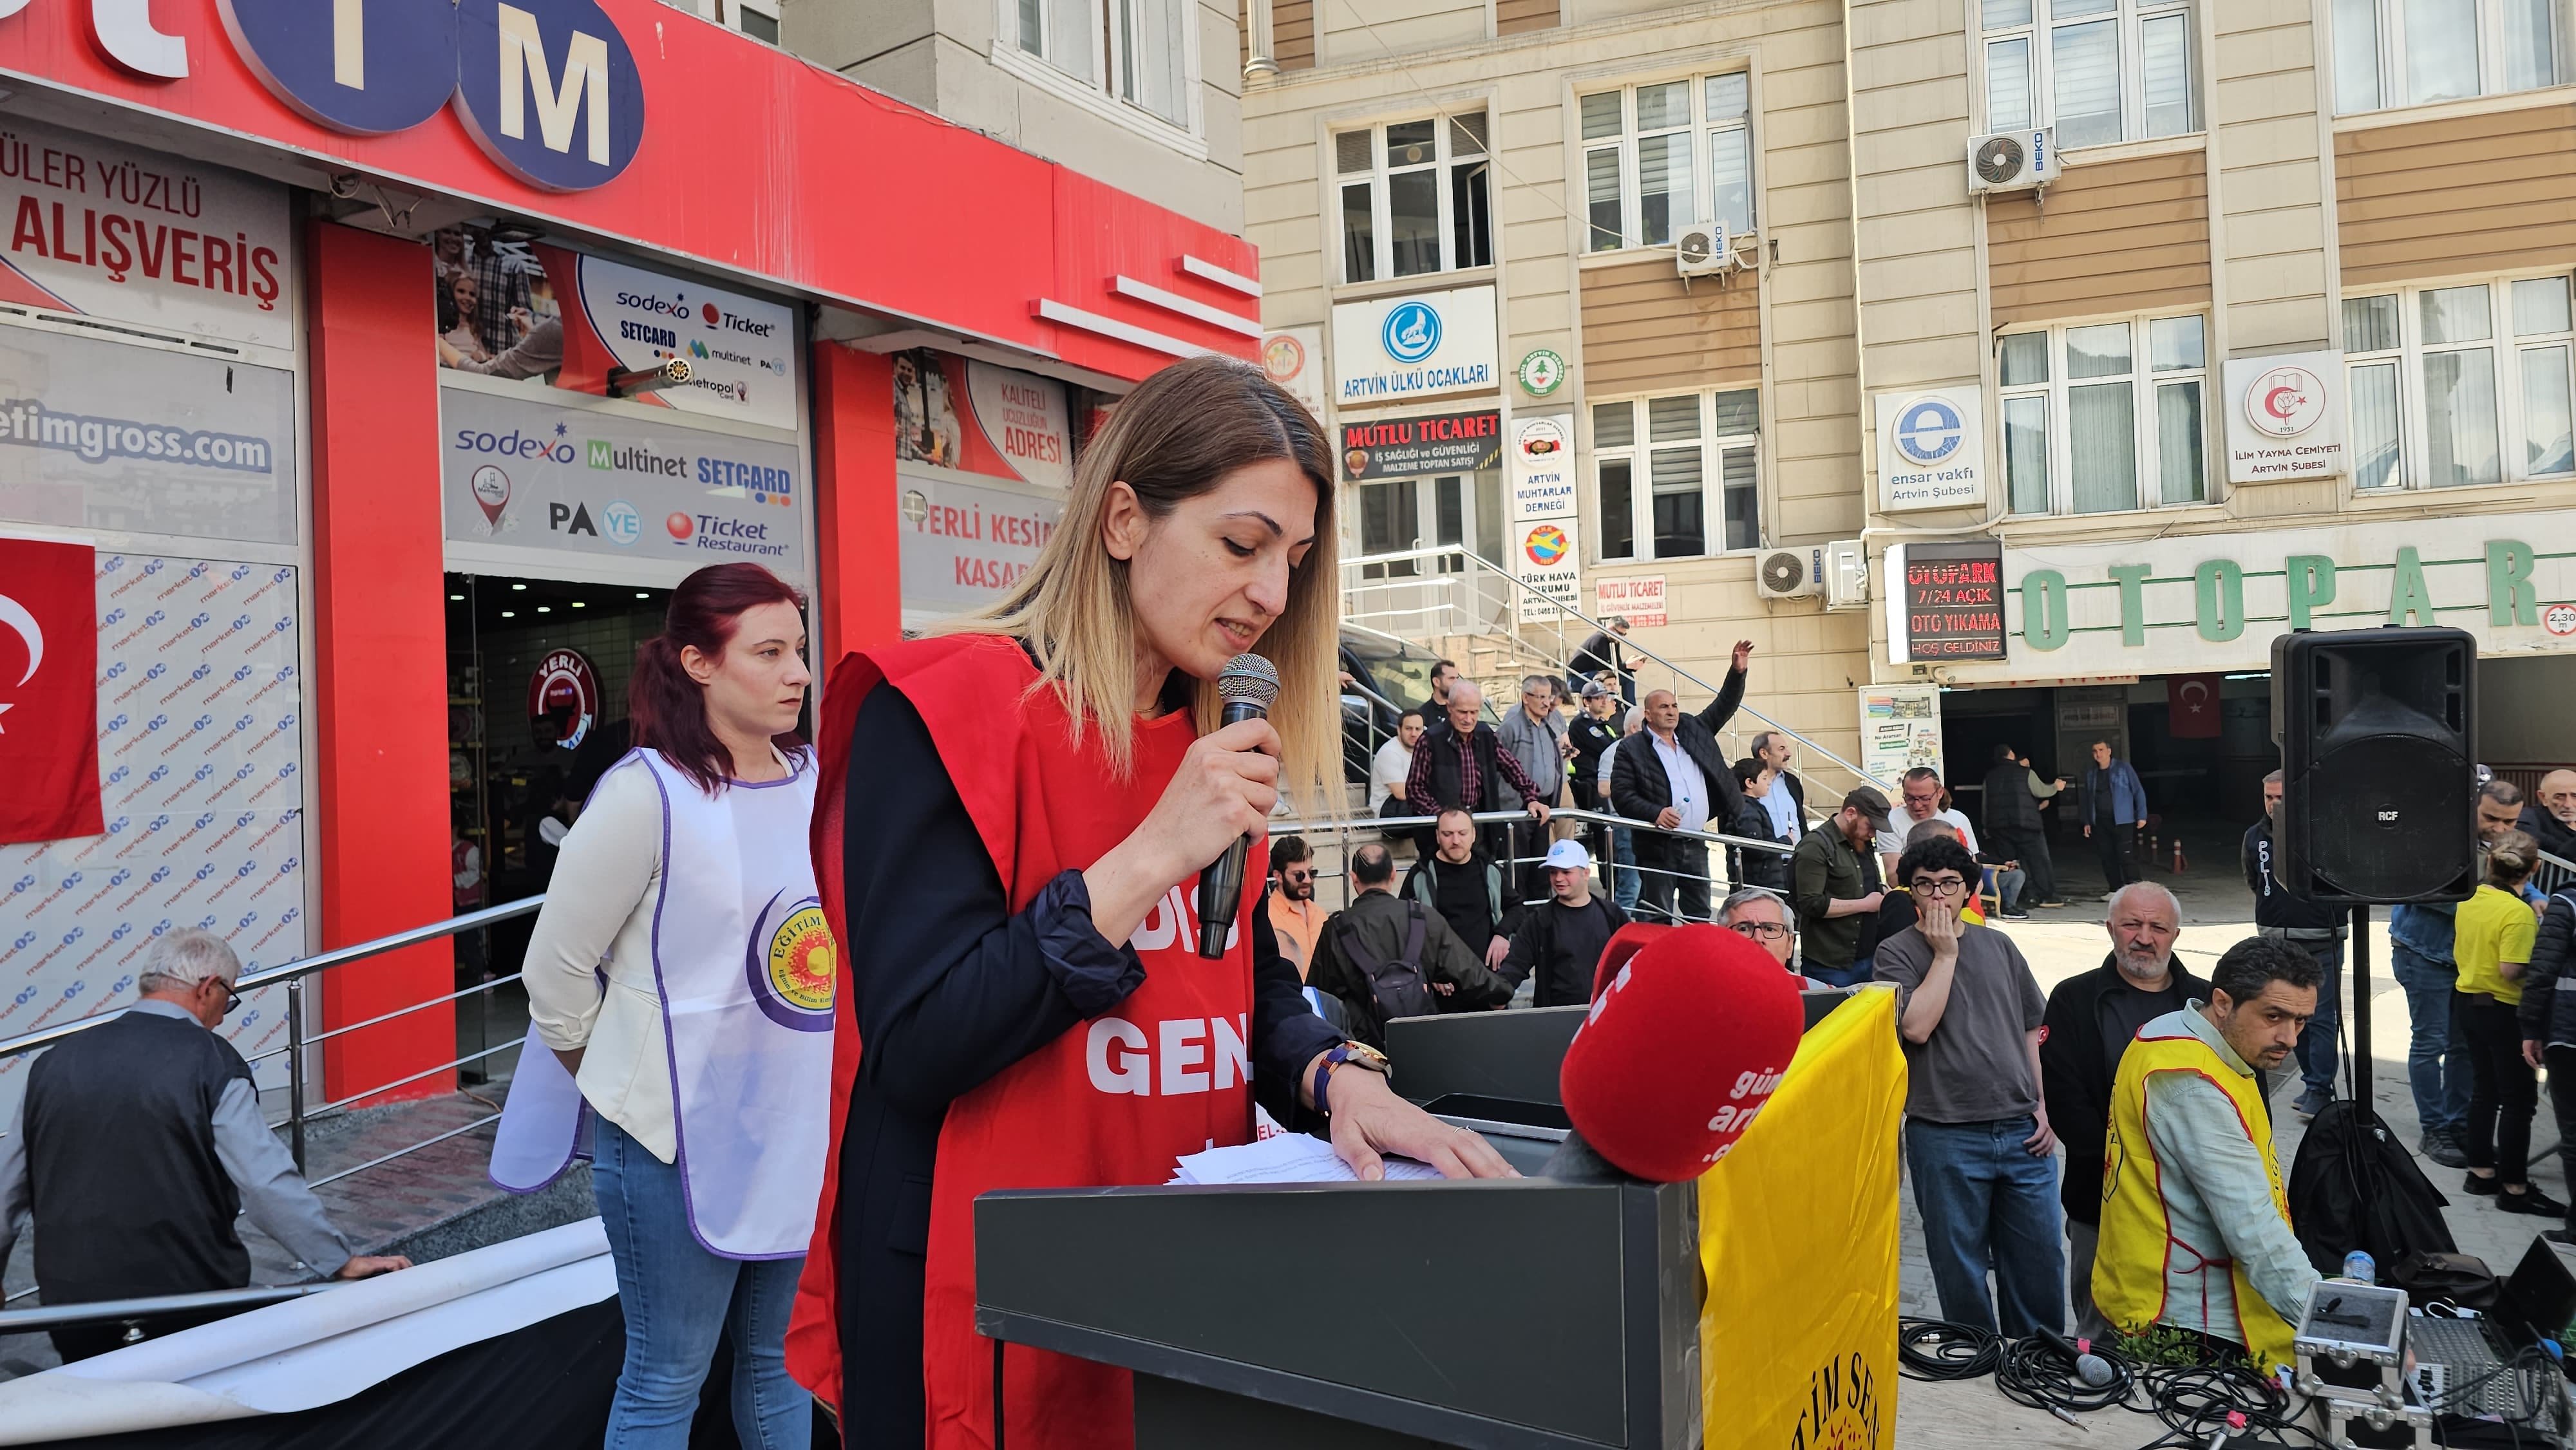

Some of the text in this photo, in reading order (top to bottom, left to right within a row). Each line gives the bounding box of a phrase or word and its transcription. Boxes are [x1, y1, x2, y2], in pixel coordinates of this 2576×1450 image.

[2034, 132, 2043, 172] BEKO
[97, 161, 201, 218] YÜZLÜ
[12, 195, 279, 311] ALIŞVERİŞ
[1715, 225, 1723, 259] BEKO
[616, 292, 690, 319] sodexo
[621, 320, 676, 348] SETCARD
[712, 350, 751, 366] multinet
[1345, 363, 1488, 398] ARTVİN ÜLKÜ OCAKLARI
[1001, 383, 1046, 411] KALİTELİ
[1346, 414, 1499, 449] MUTLU TİCARET
[455, 426, 575, 464] sodexo
[1005, 426, 1063, 464] ADRESİ
[1384, 448, 1419, 462] SAĞLIĞI
[1420, 449, 1431, 458] ve
[1432, 442, 1480, 457] GÜVENLİĞİ
[2257, 449, 2292, 459] YAYMA
[589, 441, 687, 478] Multinet
[1383, 456, 1474, 473] MALZEME TOPTAN SATIŞI
[697, 457, 791, 494] SETCARD
[1528, 471, 1560, 485] ARTVİN
[1891, 467, 1973, 485] ensar vakfı
[1517, 486, 1572, 500] MUHTARLAR
[1892, 484, 1975, 500] Artvin Şubesi
[1526, 498, 1565, 513] DERNEĞİ
[697, 515, 768, 540] Ticket
[1521, 572, 1577, 583] TÜRK HAVA
[1813, 549, 1822, 583] BEKO
[1908, 562, 1996, 585] OTOPARK
[1551, 593, 1577, 602] UBESİ
[1598, 582, 1626, 599] MUTLU
[1917, 587, 1993, 606] 7/24 AÇIK
[1911, 612, 2001, 633] OTO YIKAMA
[1911, 639, 2000, 656] HOŞ GELDİNİZ
[539, 654, 584, 678] YERLİ
[2378, 811, 2398, 822] RCF
[773, 916, 821, 959] EĞİTİM
